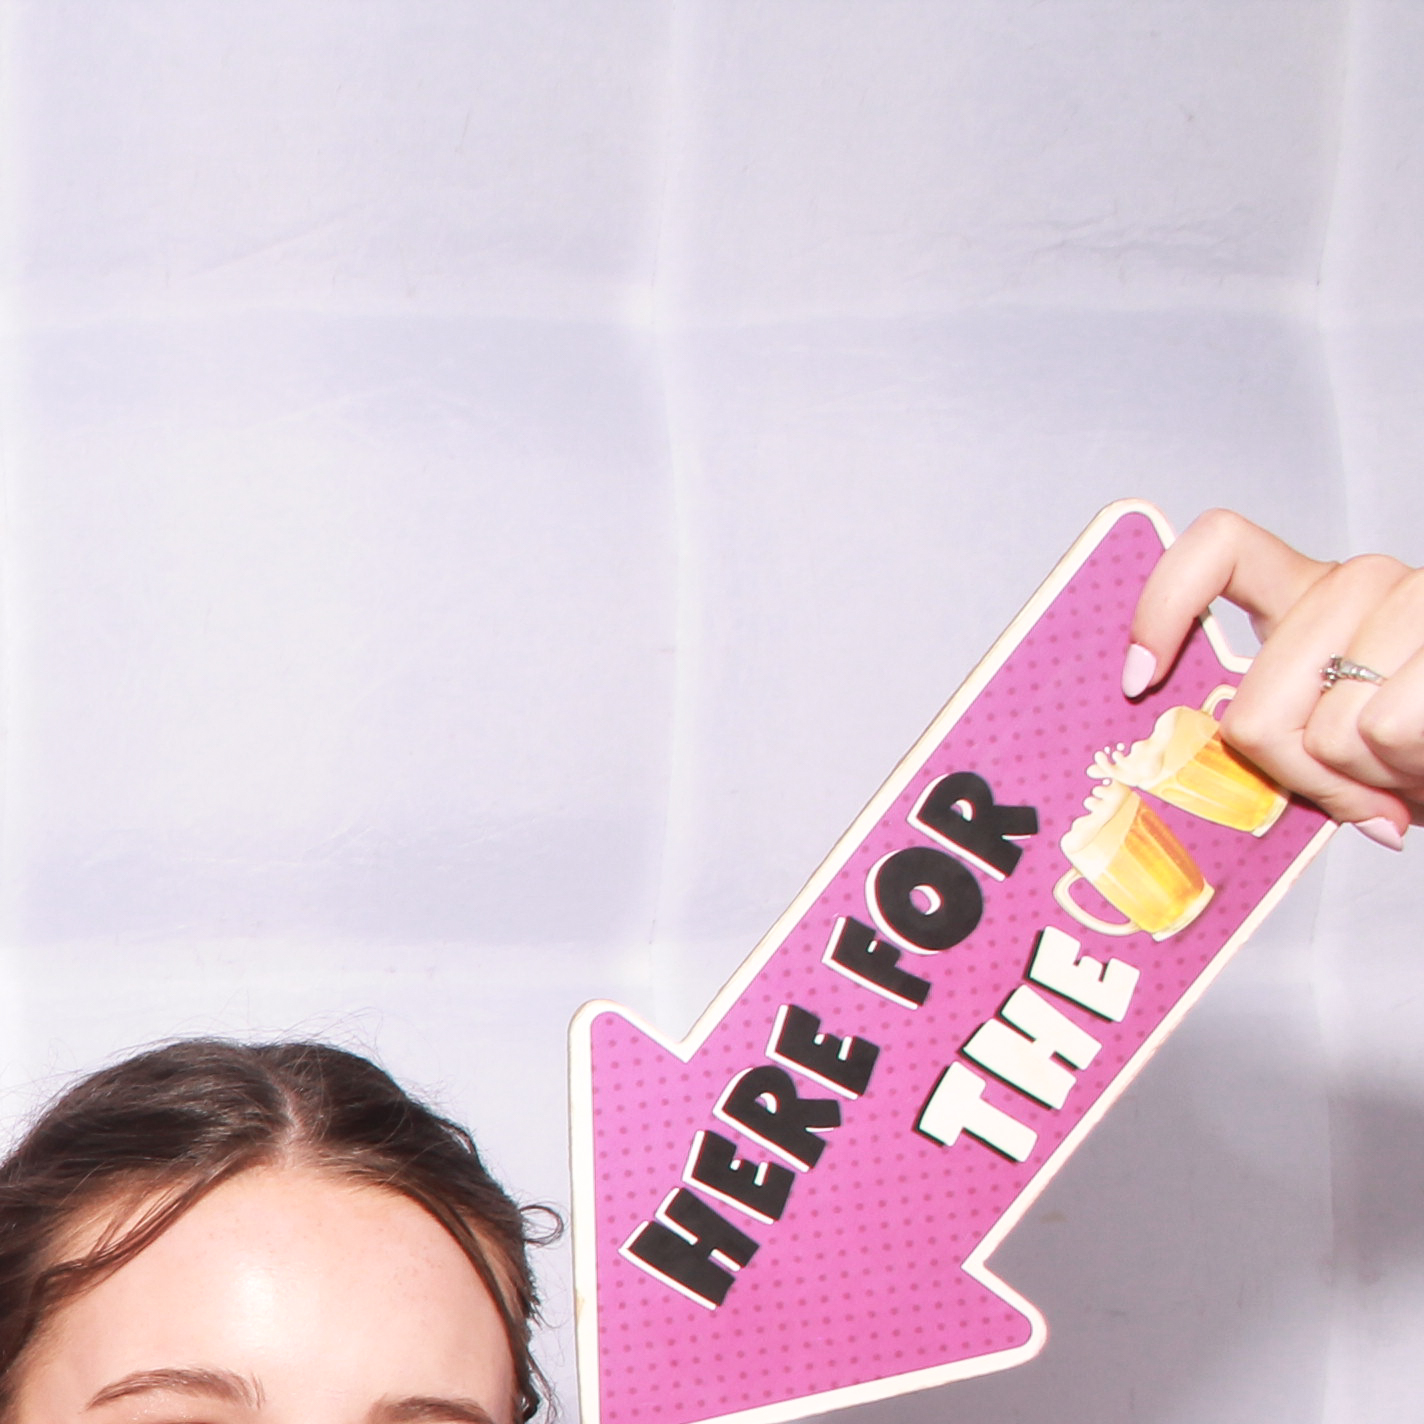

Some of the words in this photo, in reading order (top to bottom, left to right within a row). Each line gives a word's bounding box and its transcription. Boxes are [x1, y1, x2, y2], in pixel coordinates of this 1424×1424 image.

[618, 1004, 880, 1310] HERE
[821, 771, 1039, 1010] FOR
[912, 925, 1140, 1164] THE
